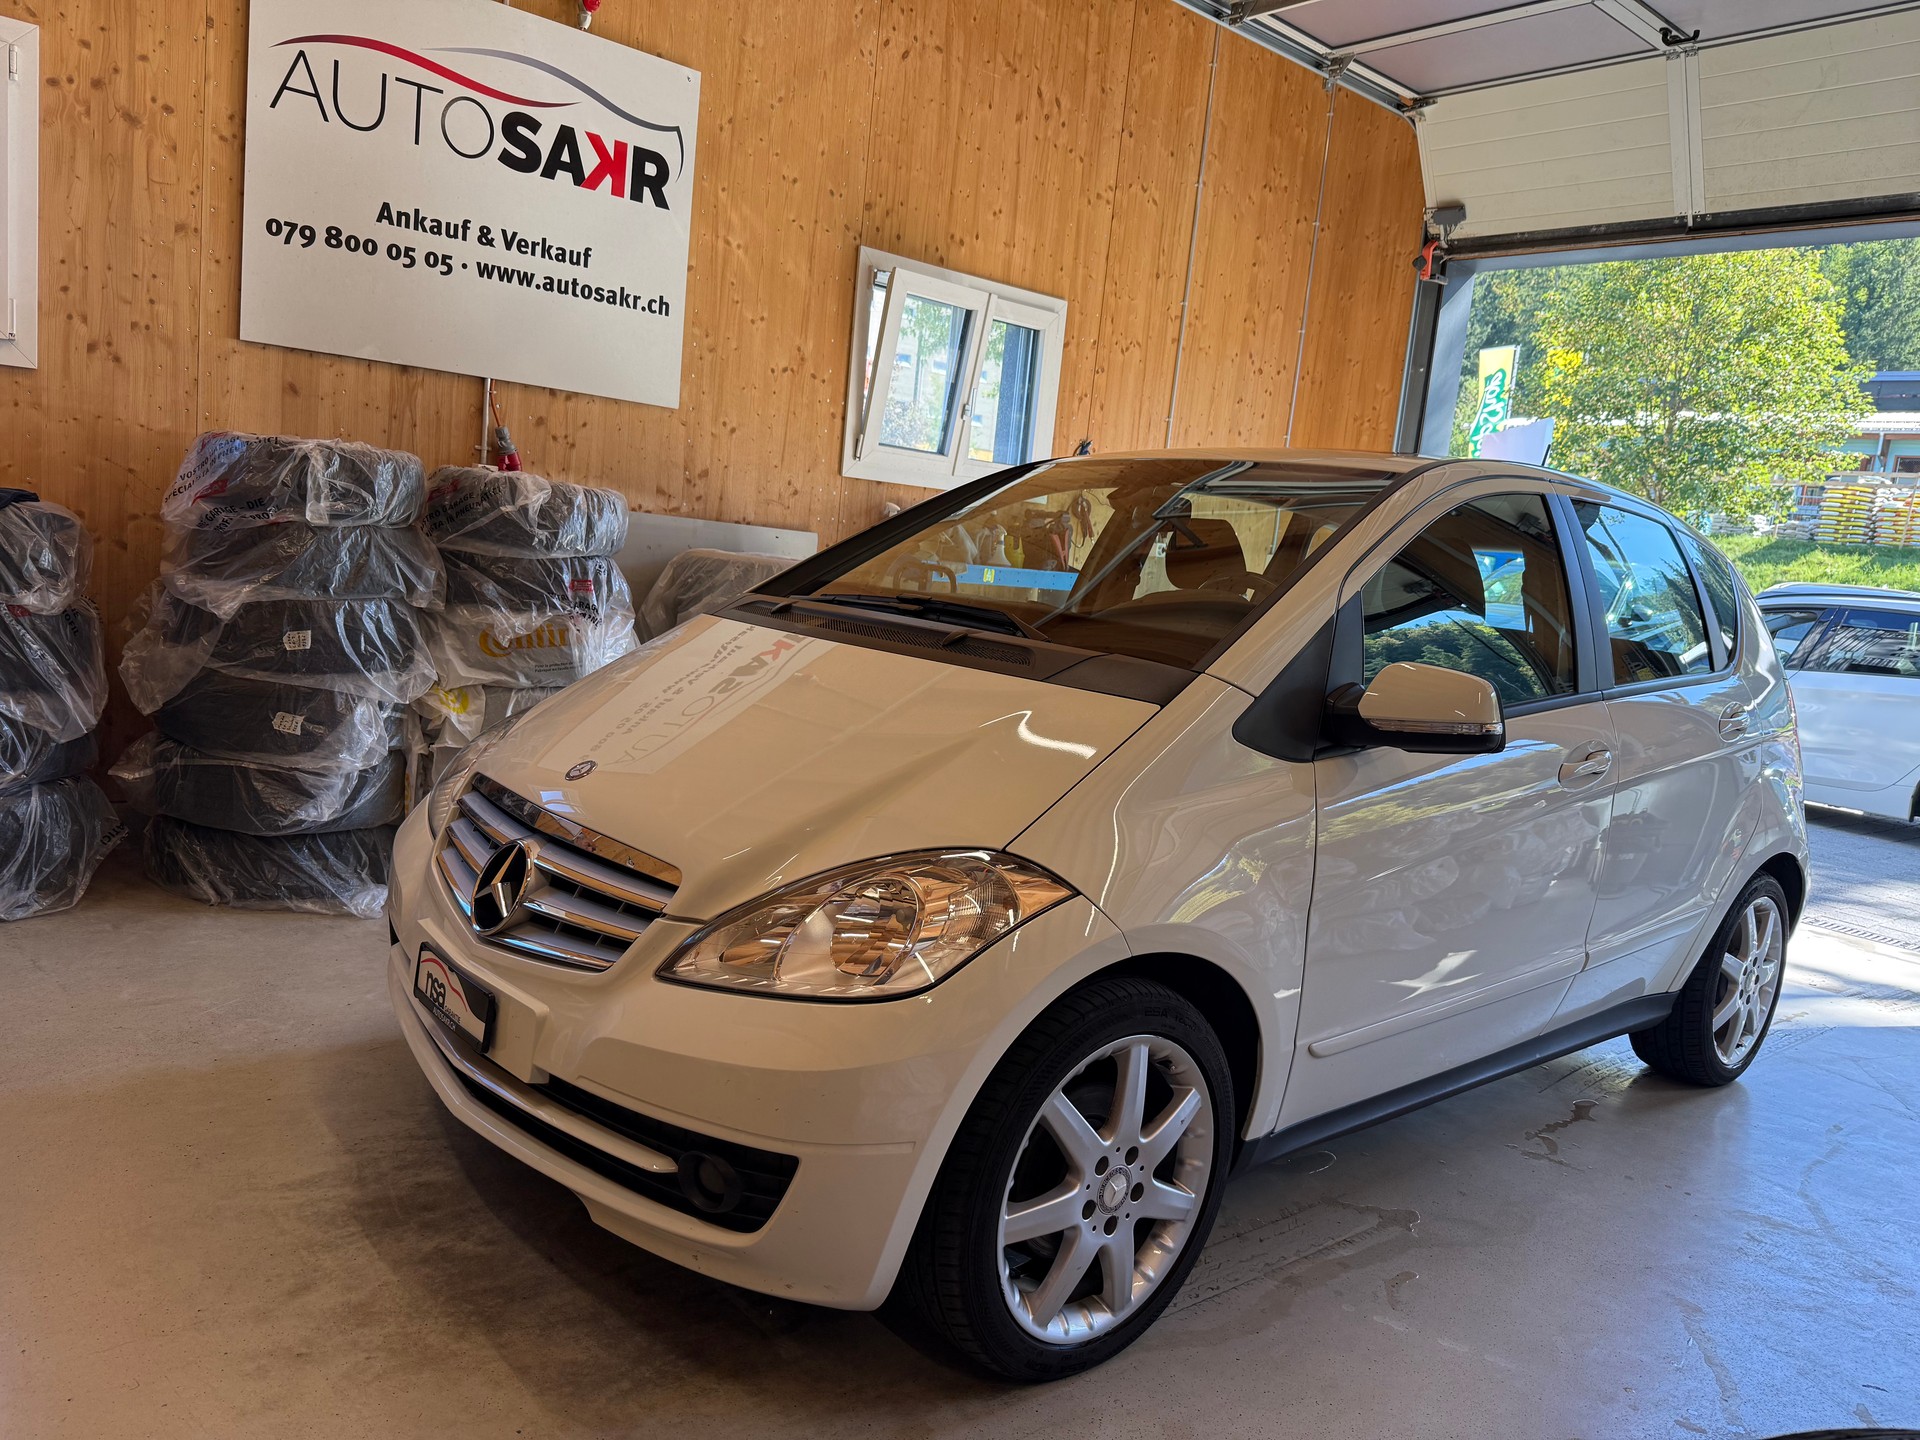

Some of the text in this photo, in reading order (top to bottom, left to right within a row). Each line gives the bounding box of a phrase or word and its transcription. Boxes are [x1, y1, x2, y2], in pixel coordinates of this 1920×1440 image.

[270, 50, 670, 210] AUTOSAKR
[266, 218, 670, 317] 079 800 05 05 www.autosakr.ch
[376, 202, 592, 268] Ankauf & Verkauf
[246, 497, 265, 509] DIE
[425, 971, 446, 1010] nsa
